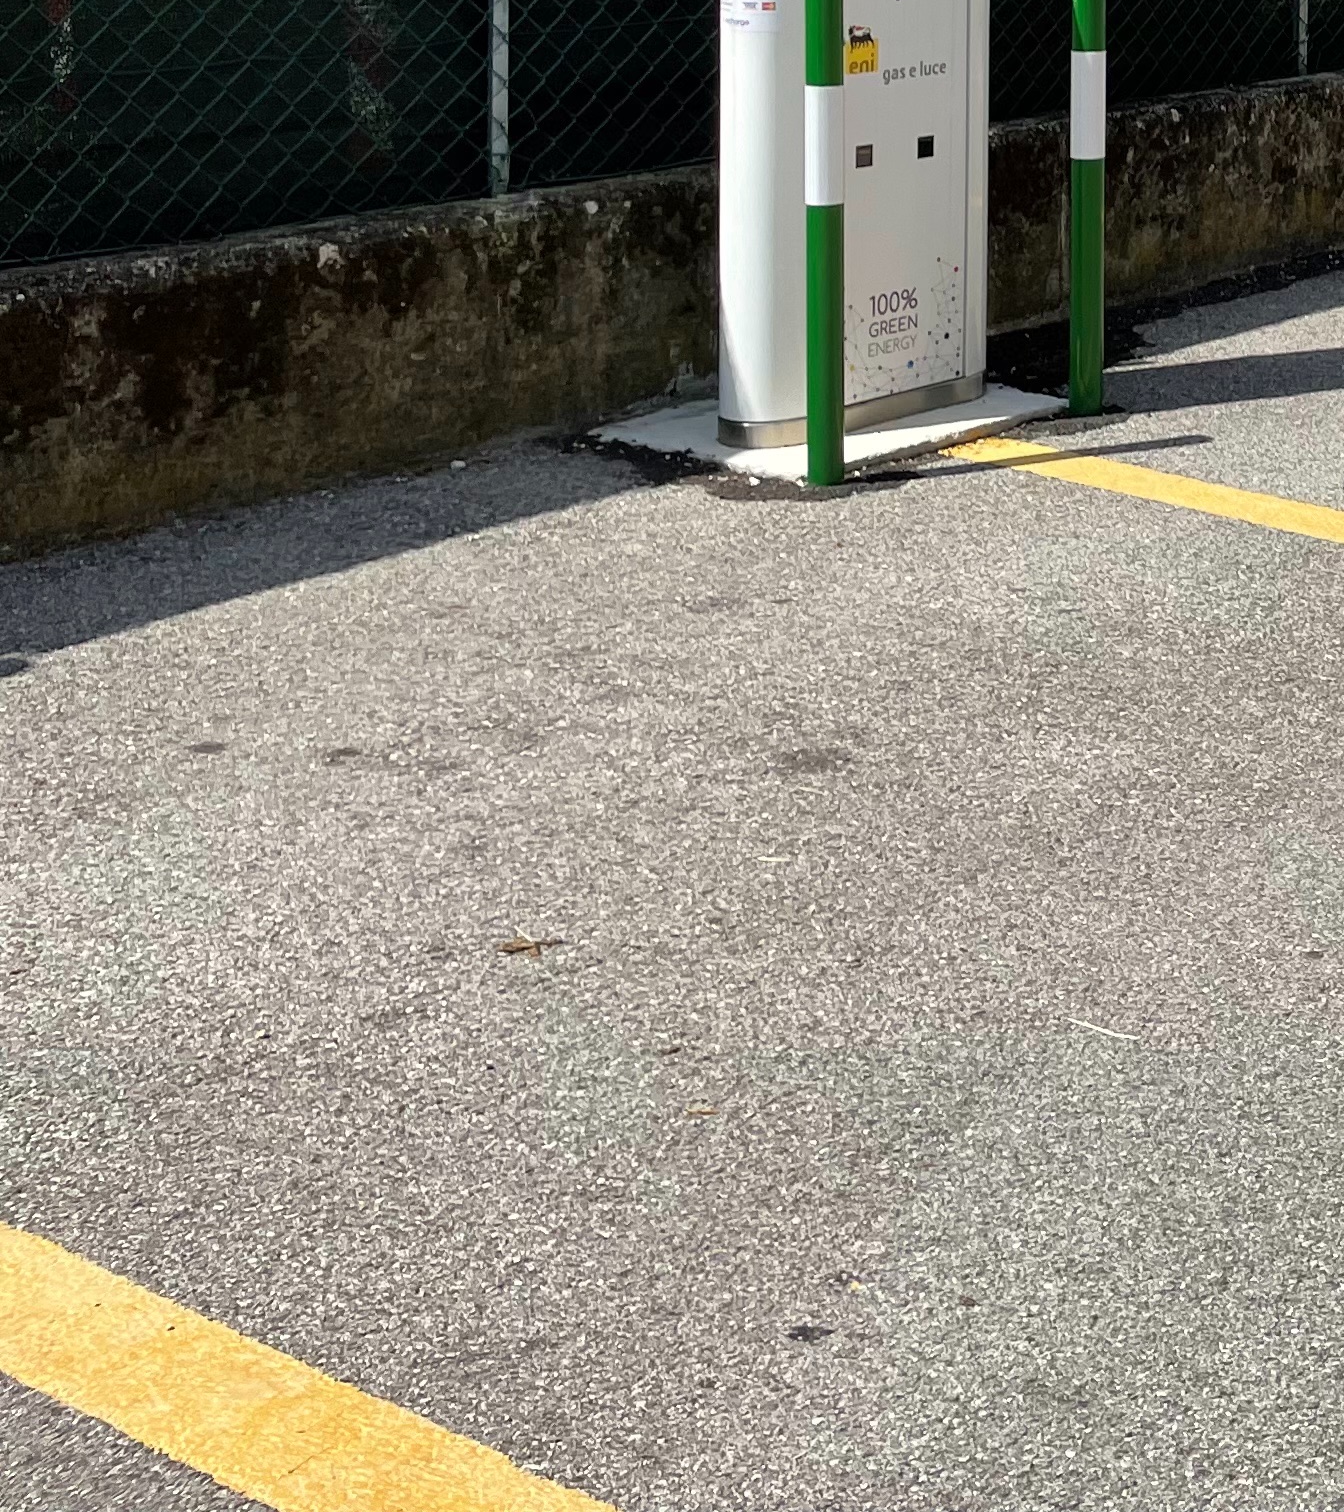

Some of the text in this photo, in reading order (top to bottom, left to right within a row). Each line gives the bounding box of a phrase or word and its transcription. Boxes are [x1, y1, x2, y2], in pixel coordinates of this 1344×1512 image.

[848, 52, 875, 75] eni
[883, 60, 947, 85] gas e luce
[869, 286, 918, 317] 100%
[868, 312, 918, 338] GREEN
[867, 333, 918, 358] ENERGY
